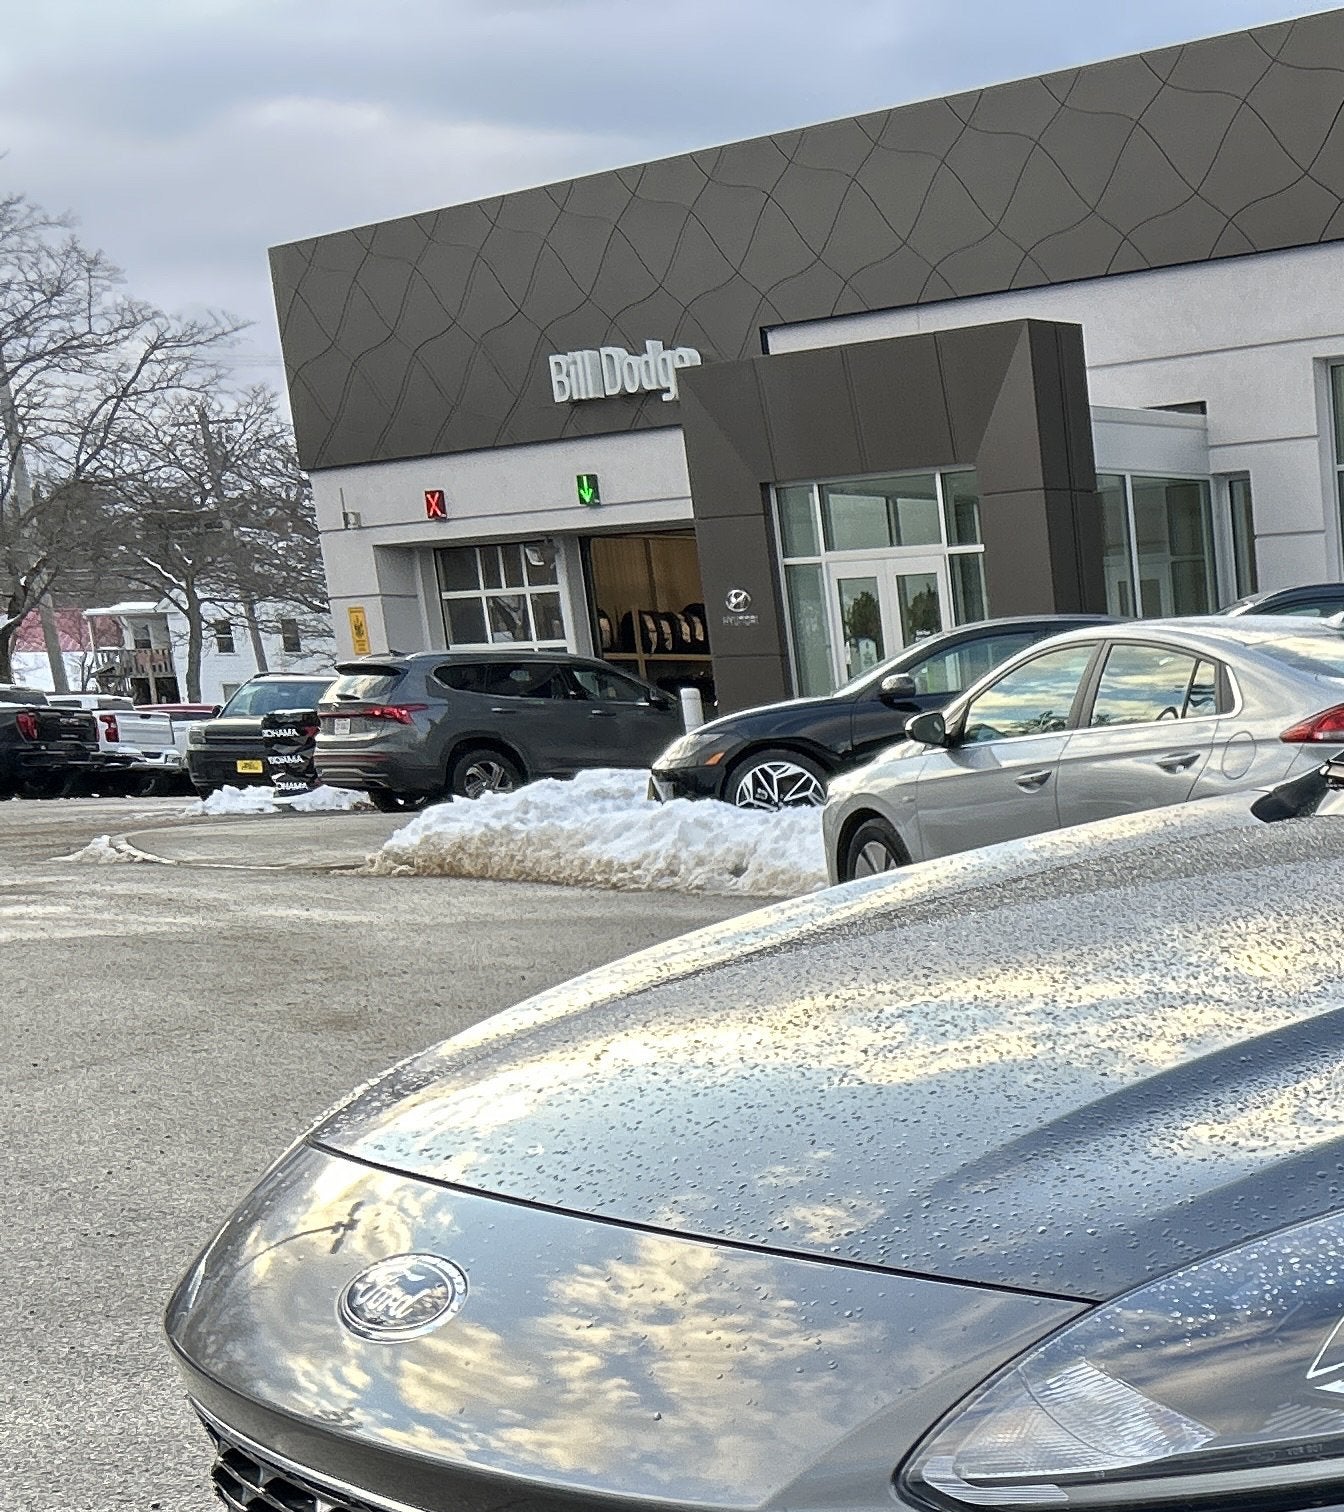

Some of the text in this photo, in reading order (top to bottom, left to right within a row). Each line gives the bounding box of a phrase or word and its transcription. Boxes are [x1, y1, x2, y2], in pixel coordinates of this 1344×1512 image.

[549, 340, 702, 402] Bill Dodge
[354, 1265, 432, 1319] Ford
